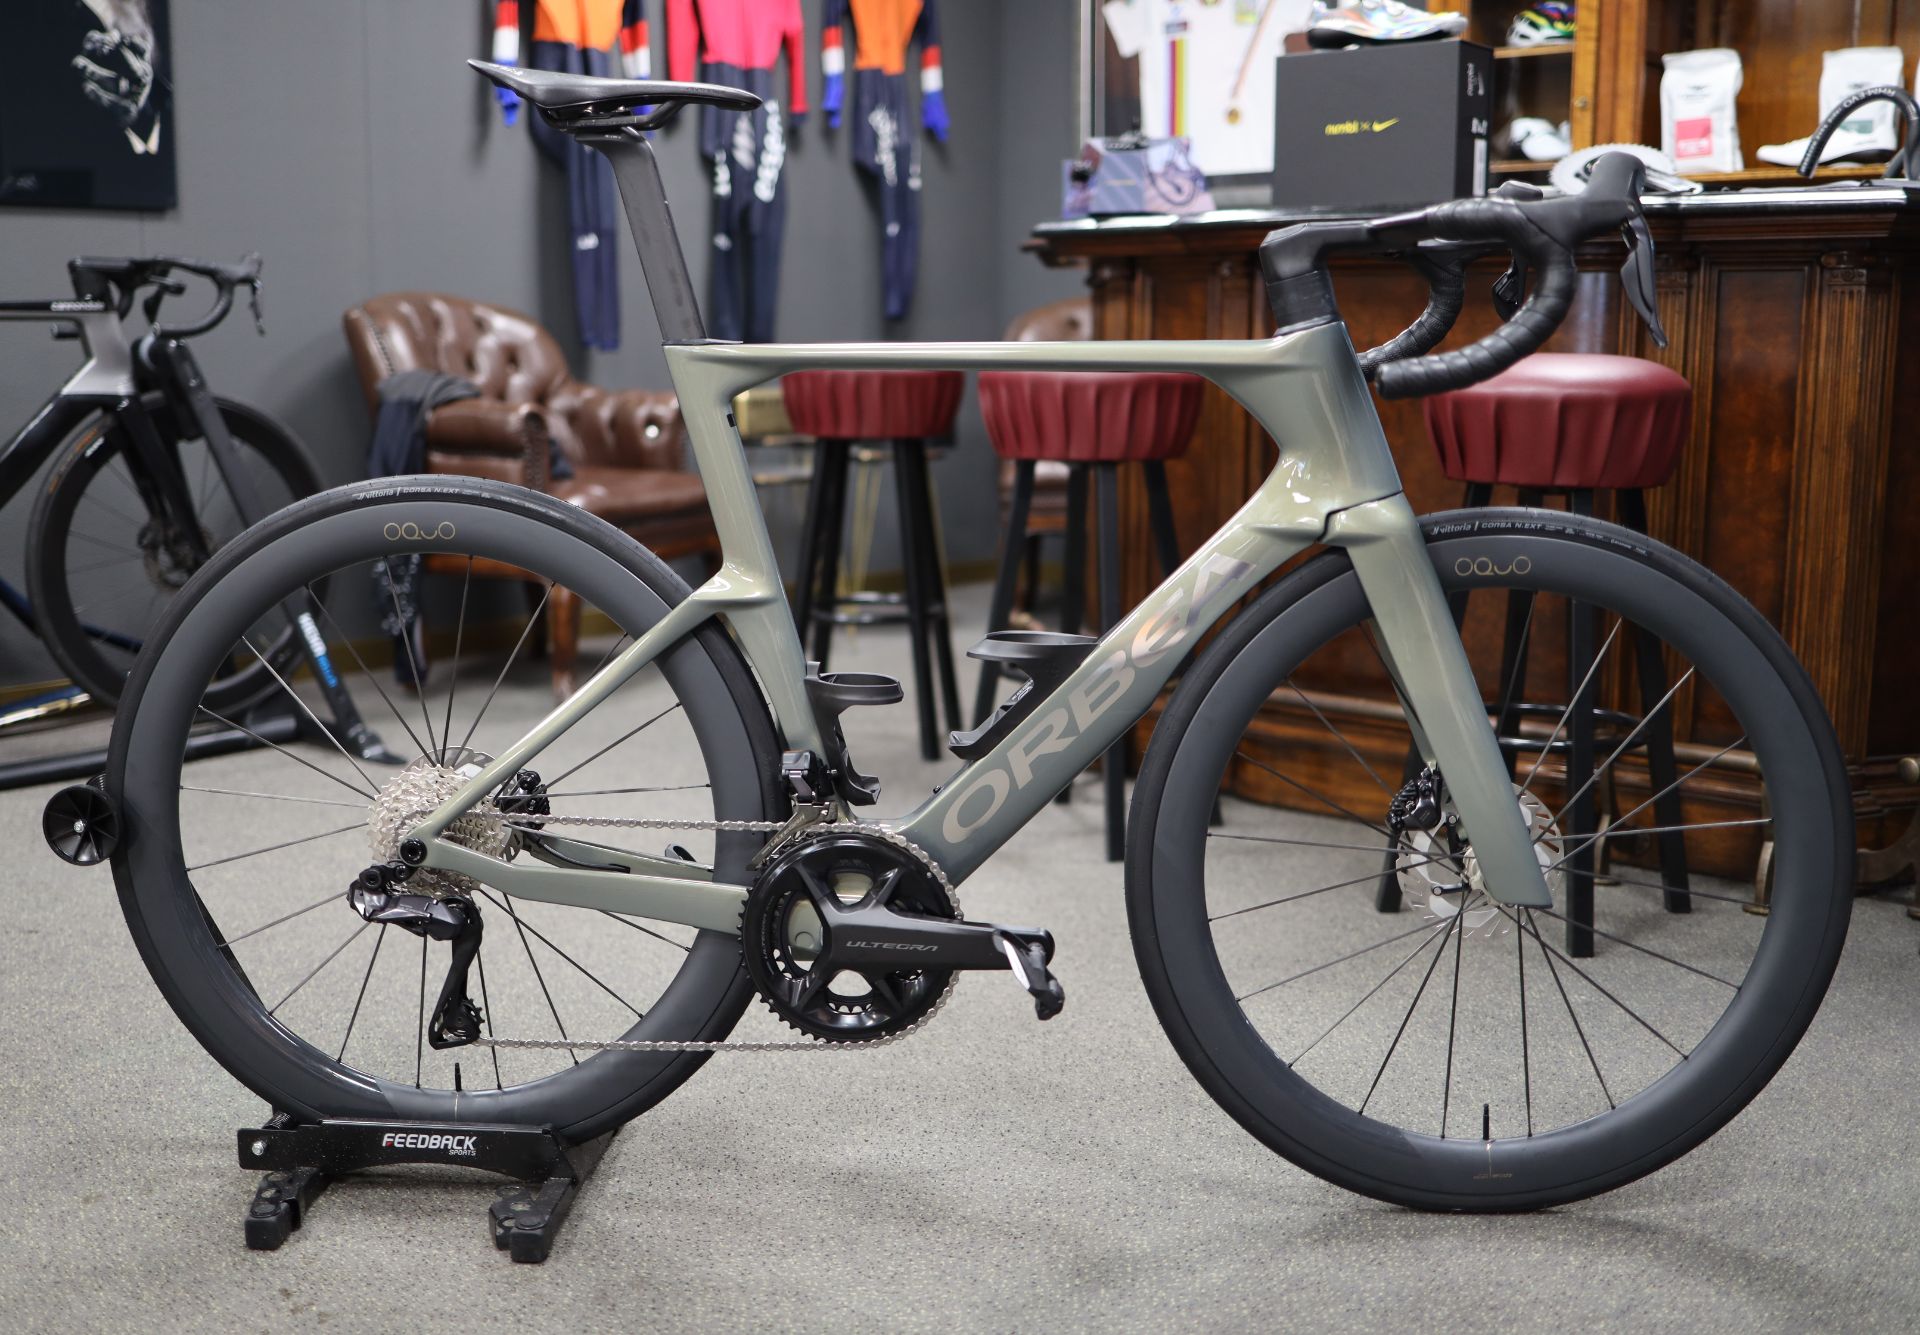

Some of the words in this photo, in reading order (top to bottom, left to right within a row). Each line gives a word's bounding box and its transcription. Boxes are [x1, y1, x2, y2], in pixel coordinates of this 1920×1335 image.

[365, 488, 394, 499] vittoria
[403, 486, 432, 494] CORSA
[383, 521, 456, 542] OQUO
[1439, 522, 1472, 534] vittoria
[1481, 521, 1512, 530] CORSA
[1514, 522, 1542, 530] N.EXT
[1454, 555, 1532, 577] OQUO
[942, 551, 1257, 844] ORBEA
[846, 940, 938, 952] ULTEGRA
[382, 1133, 477, 1151] FEEDBACK
[448, 1149, 477, 1157] SPORTS
